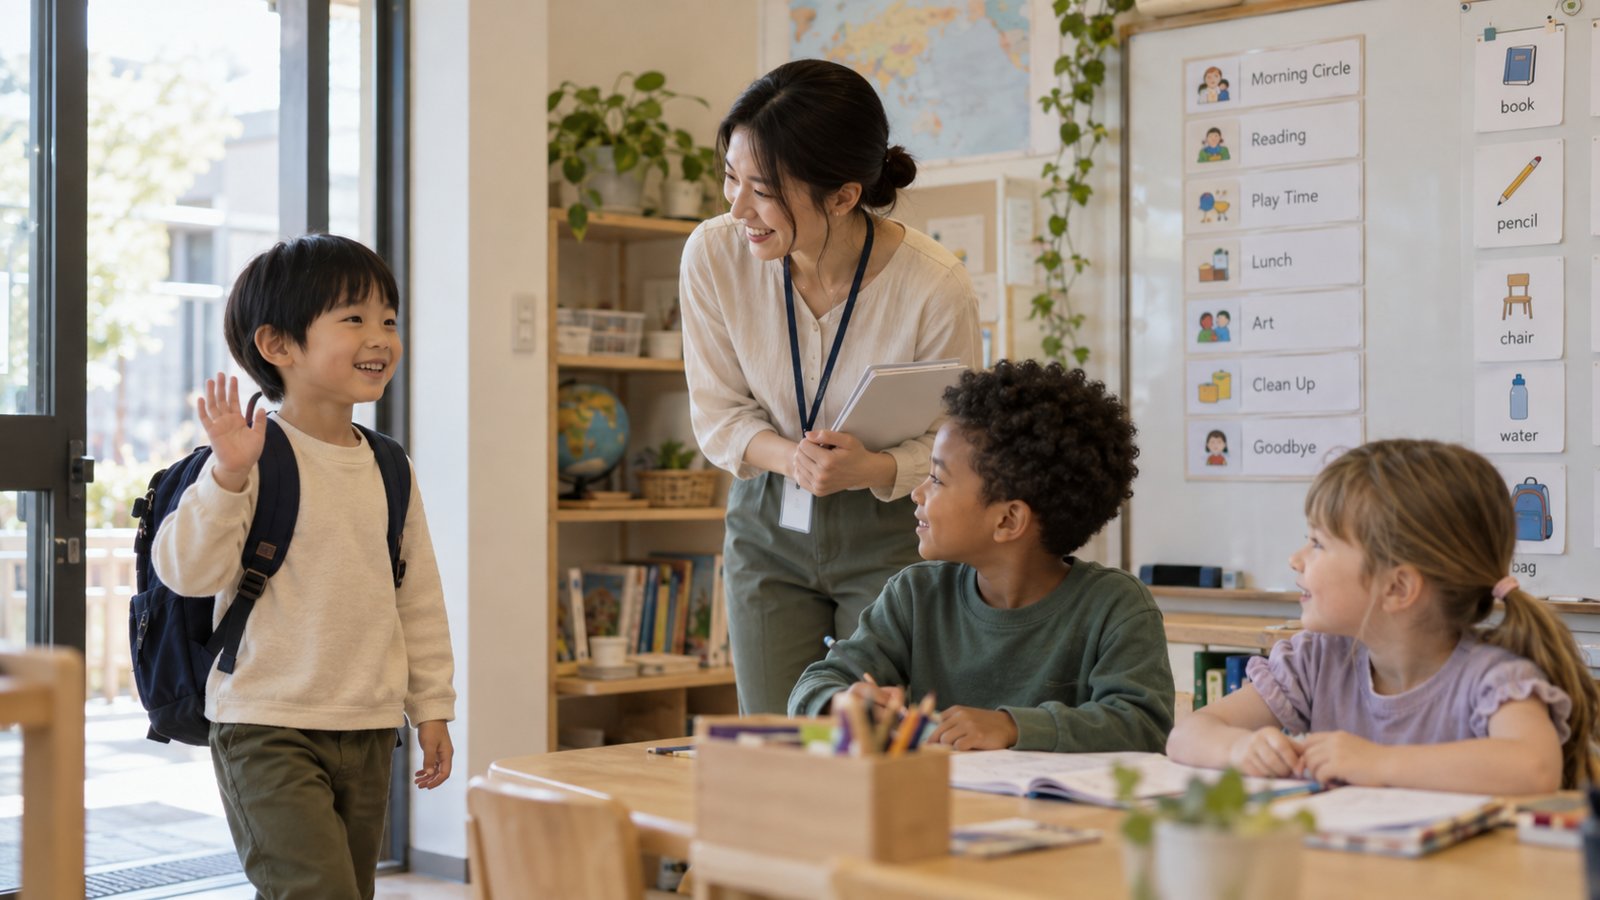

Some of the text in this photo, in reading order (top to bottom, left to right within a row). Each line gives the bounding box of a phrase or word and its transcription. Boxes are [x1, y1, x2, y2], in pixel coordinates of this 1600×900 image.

[1251, 61, 1351, 86] Morning Circle
[1500, 97, 1535, 114] book
[1251, 128, 1307, 147] Reading
[1252, 188, 1319, 210] Play Time
[1497, 213, 1538, 233] pencil
[1251, 252, 1293, 270] Lunch
[1252, 315, 1274, 330] Art
[1500, 331, 1534, 346] chair
[1252, 376, 1316, 394] Clean Up
[1500, 429, 1539, 442] water
[1253, 439, 1317, 457] Goodbye
[1512, 559, 1537, 577] bag
